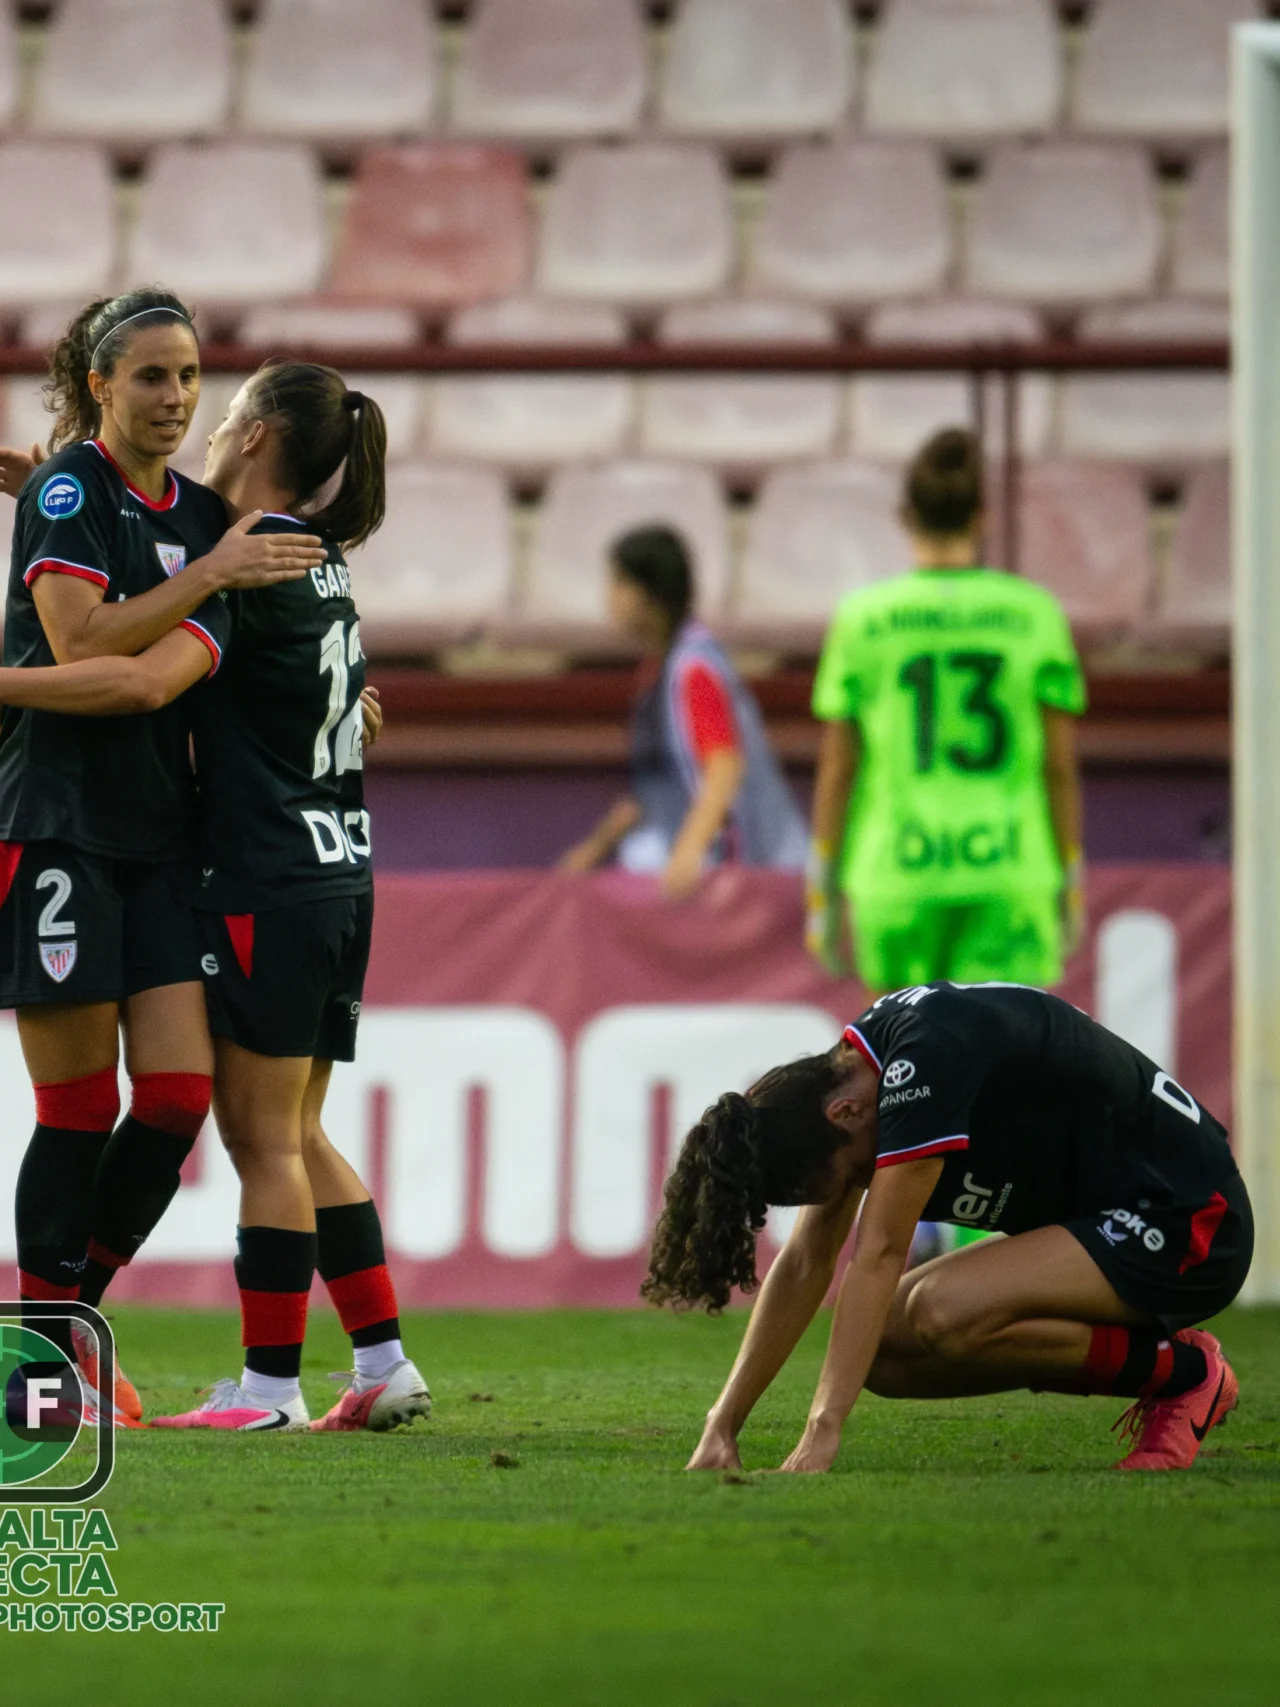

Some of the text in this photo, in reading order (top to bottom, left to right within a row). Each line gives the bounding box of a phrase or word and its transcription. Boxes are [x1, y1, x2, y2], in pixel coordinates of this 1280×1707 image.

[310, 563, 352, 598] GAR
[898, 652, 1010, 776] 13
[898, 819, 1021, 870] DIGI
[36, 868, 76, 937] 2
